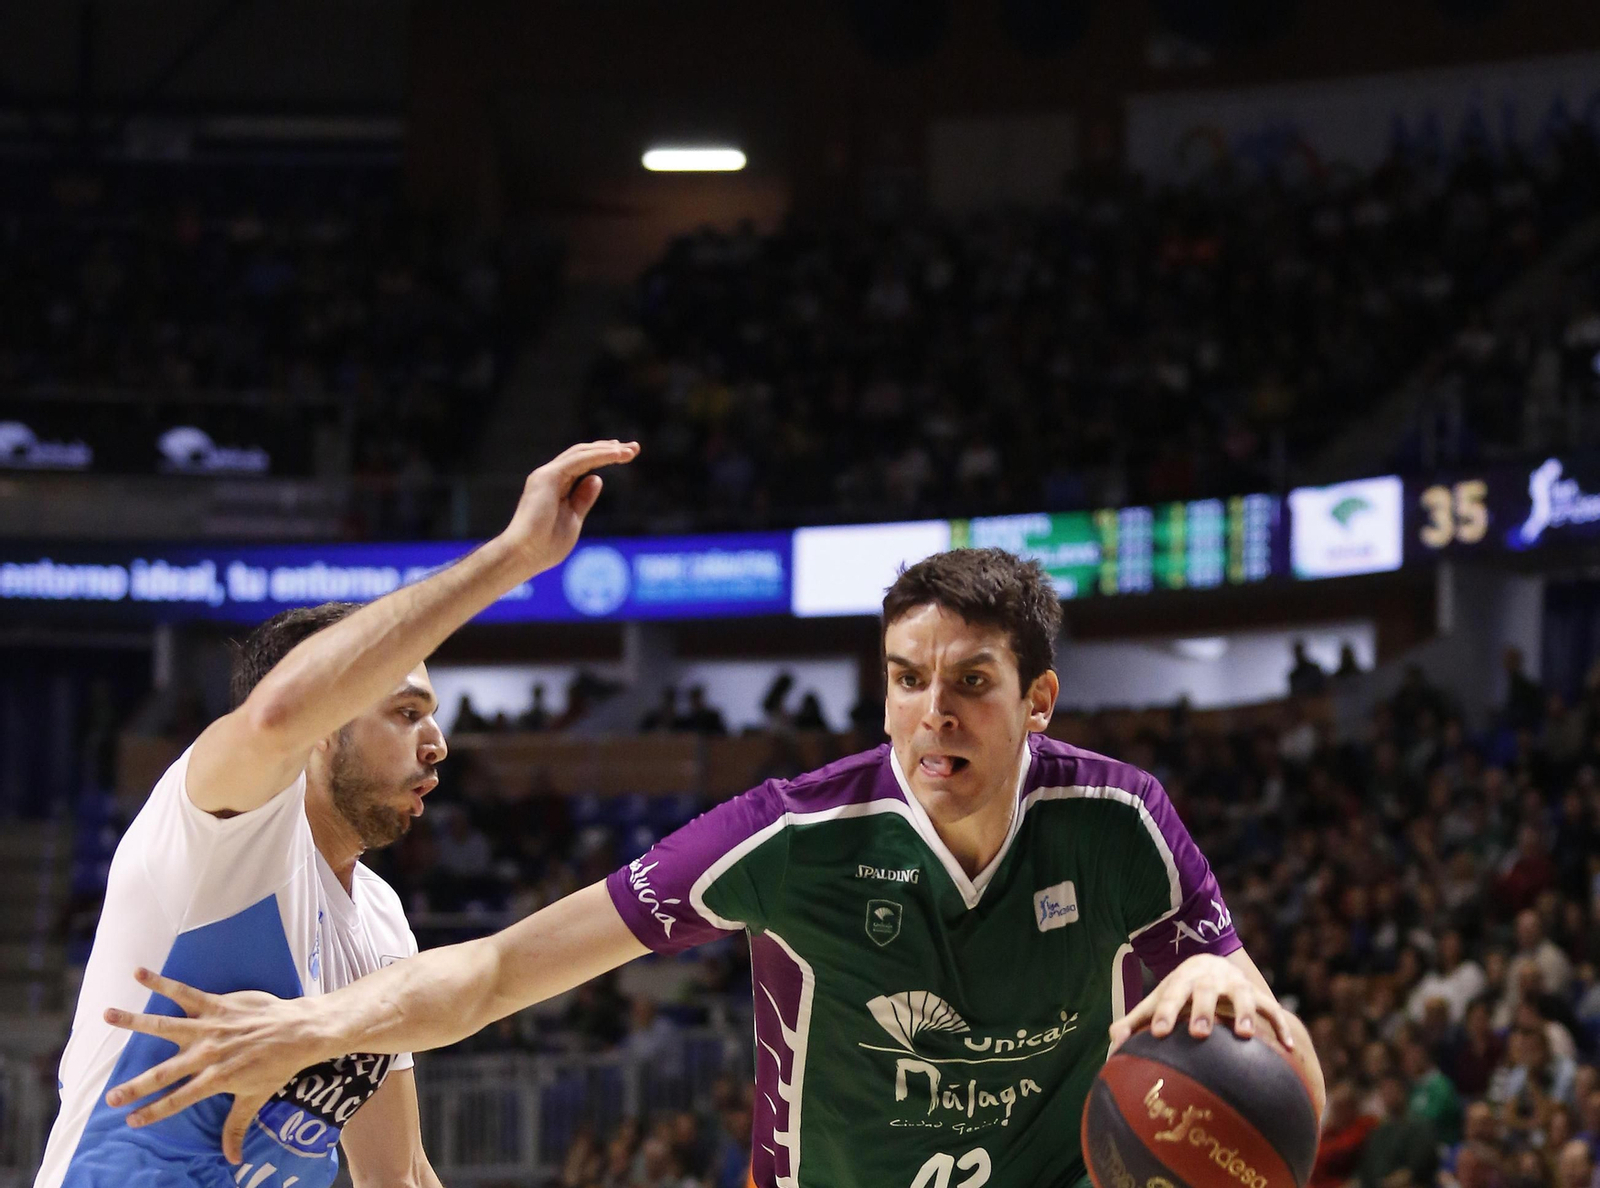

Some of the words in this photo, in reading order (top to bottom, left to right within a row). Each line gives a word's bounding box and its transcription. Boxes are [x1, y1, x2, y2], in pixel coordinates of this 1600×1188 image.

[1420, 479, 1488, 548] 35
[856, 865, 920, 885] SPALDING
[894, 1058, 1042, 1127] Málaga
